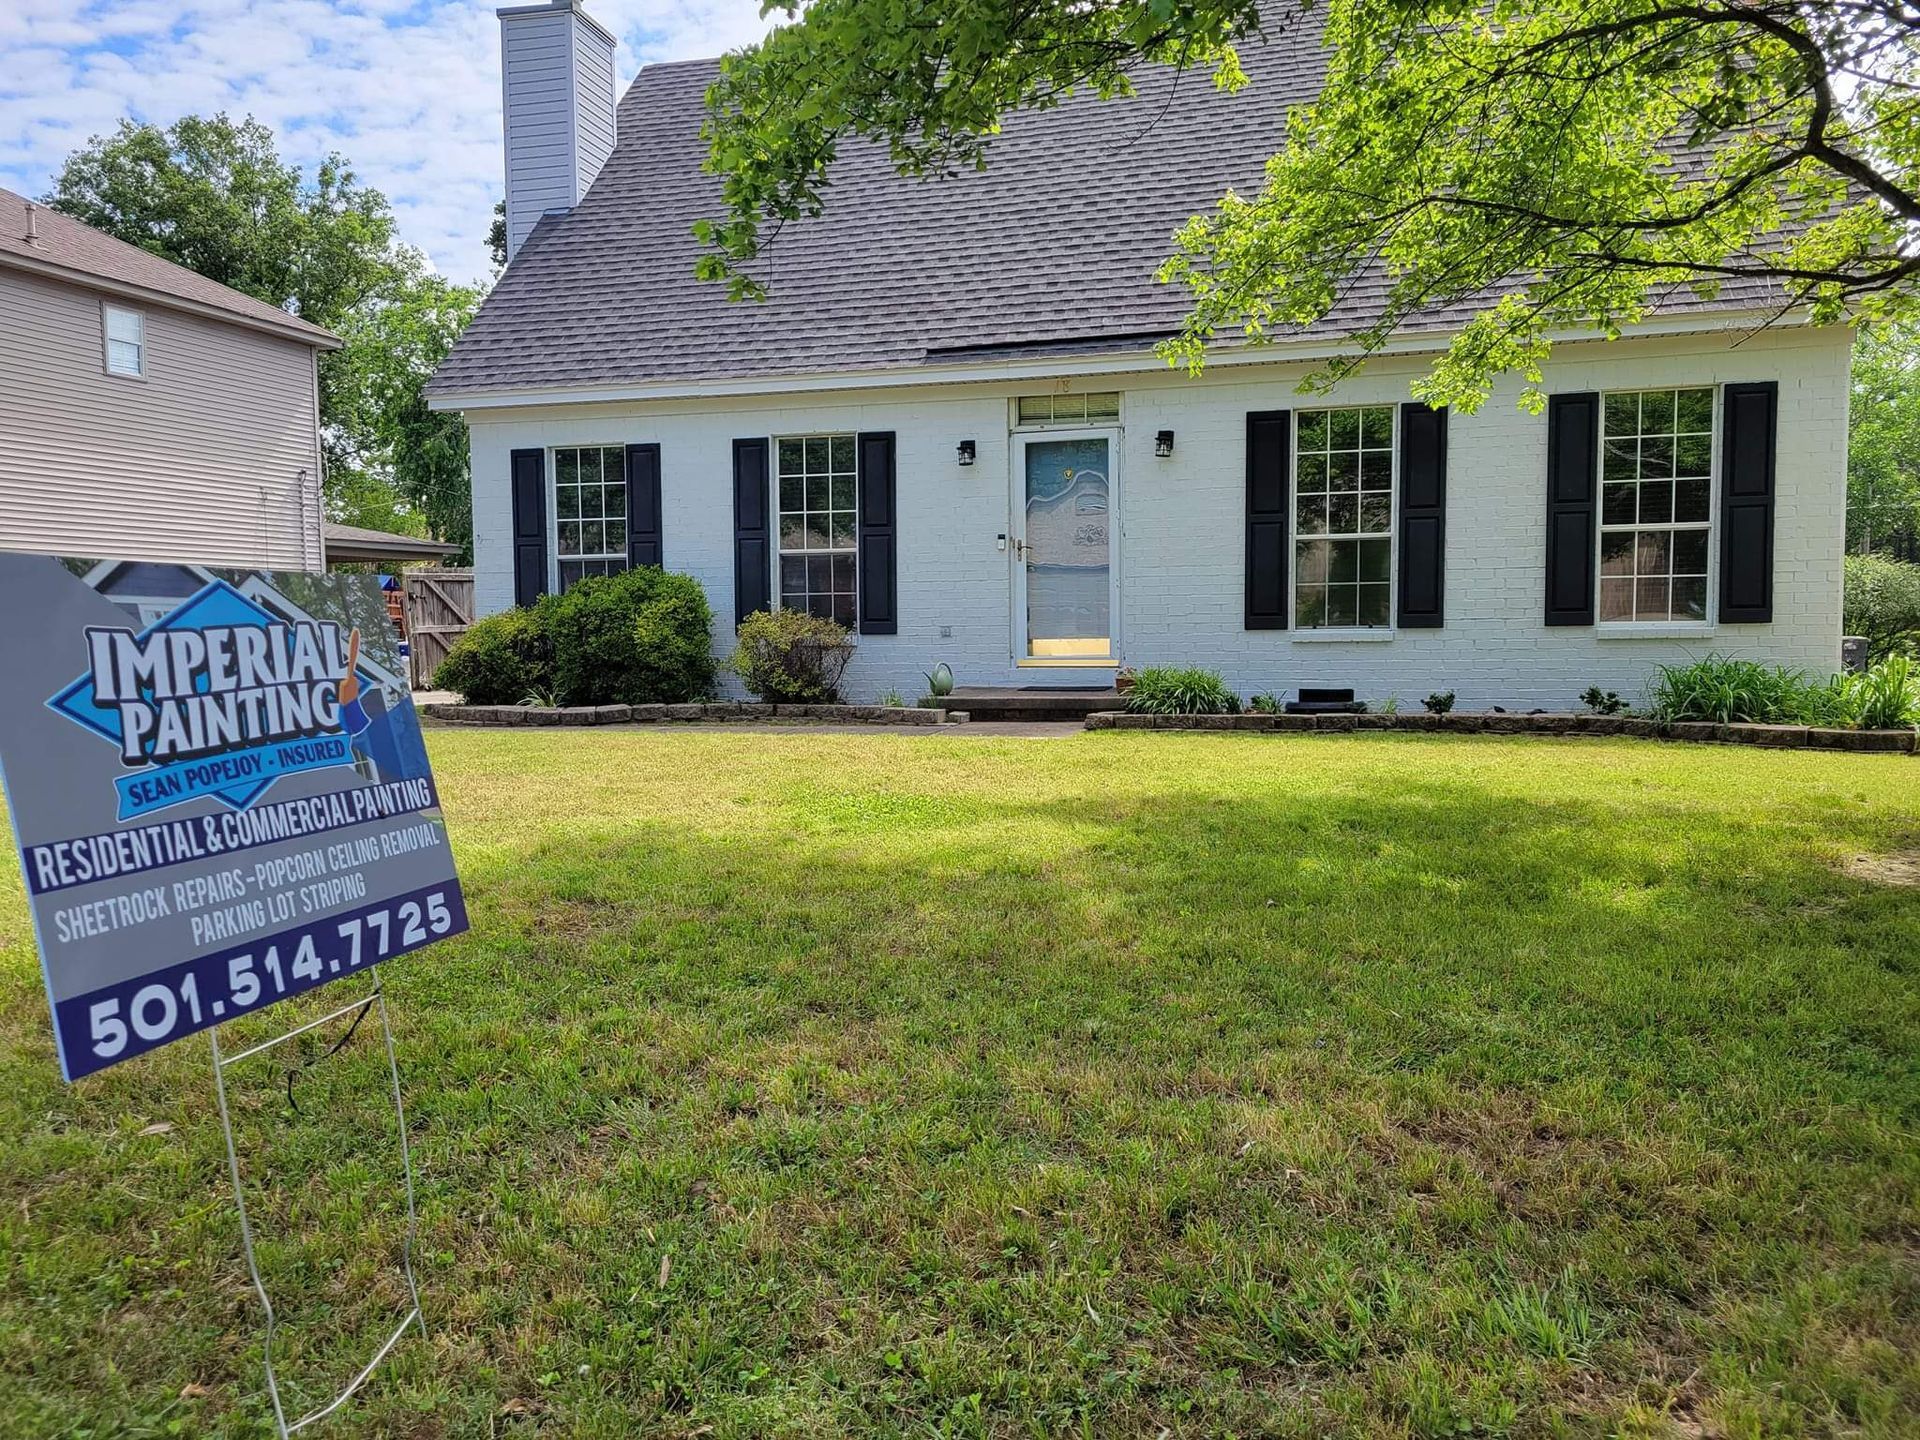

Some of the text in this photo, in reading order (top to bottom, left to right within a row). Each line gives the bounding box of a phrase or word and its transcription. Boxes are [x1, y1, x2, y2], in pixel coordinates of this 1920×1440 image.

[88, 622, 348, 701] IMPERIAL
[120, 680, 341, 758] PAINTING
[128, 772, 182, 809] SEAN
[185, 754, 264, 791] POPEJOY
[277, 740, 346, 769] INSURED
[33, 777, 432, 890] RESIDENTIAL & COMMERCIAL PAINTING
[54, 886, 171, 943] SHEETROCK
[327, 837, 380, 872] CEILING
[380, 823, 440, 853] REMOVAL
[191, 871, 366, 946] PARKING LOT STRIPING
[90, 892, 452, 1058] 501.514.7725
